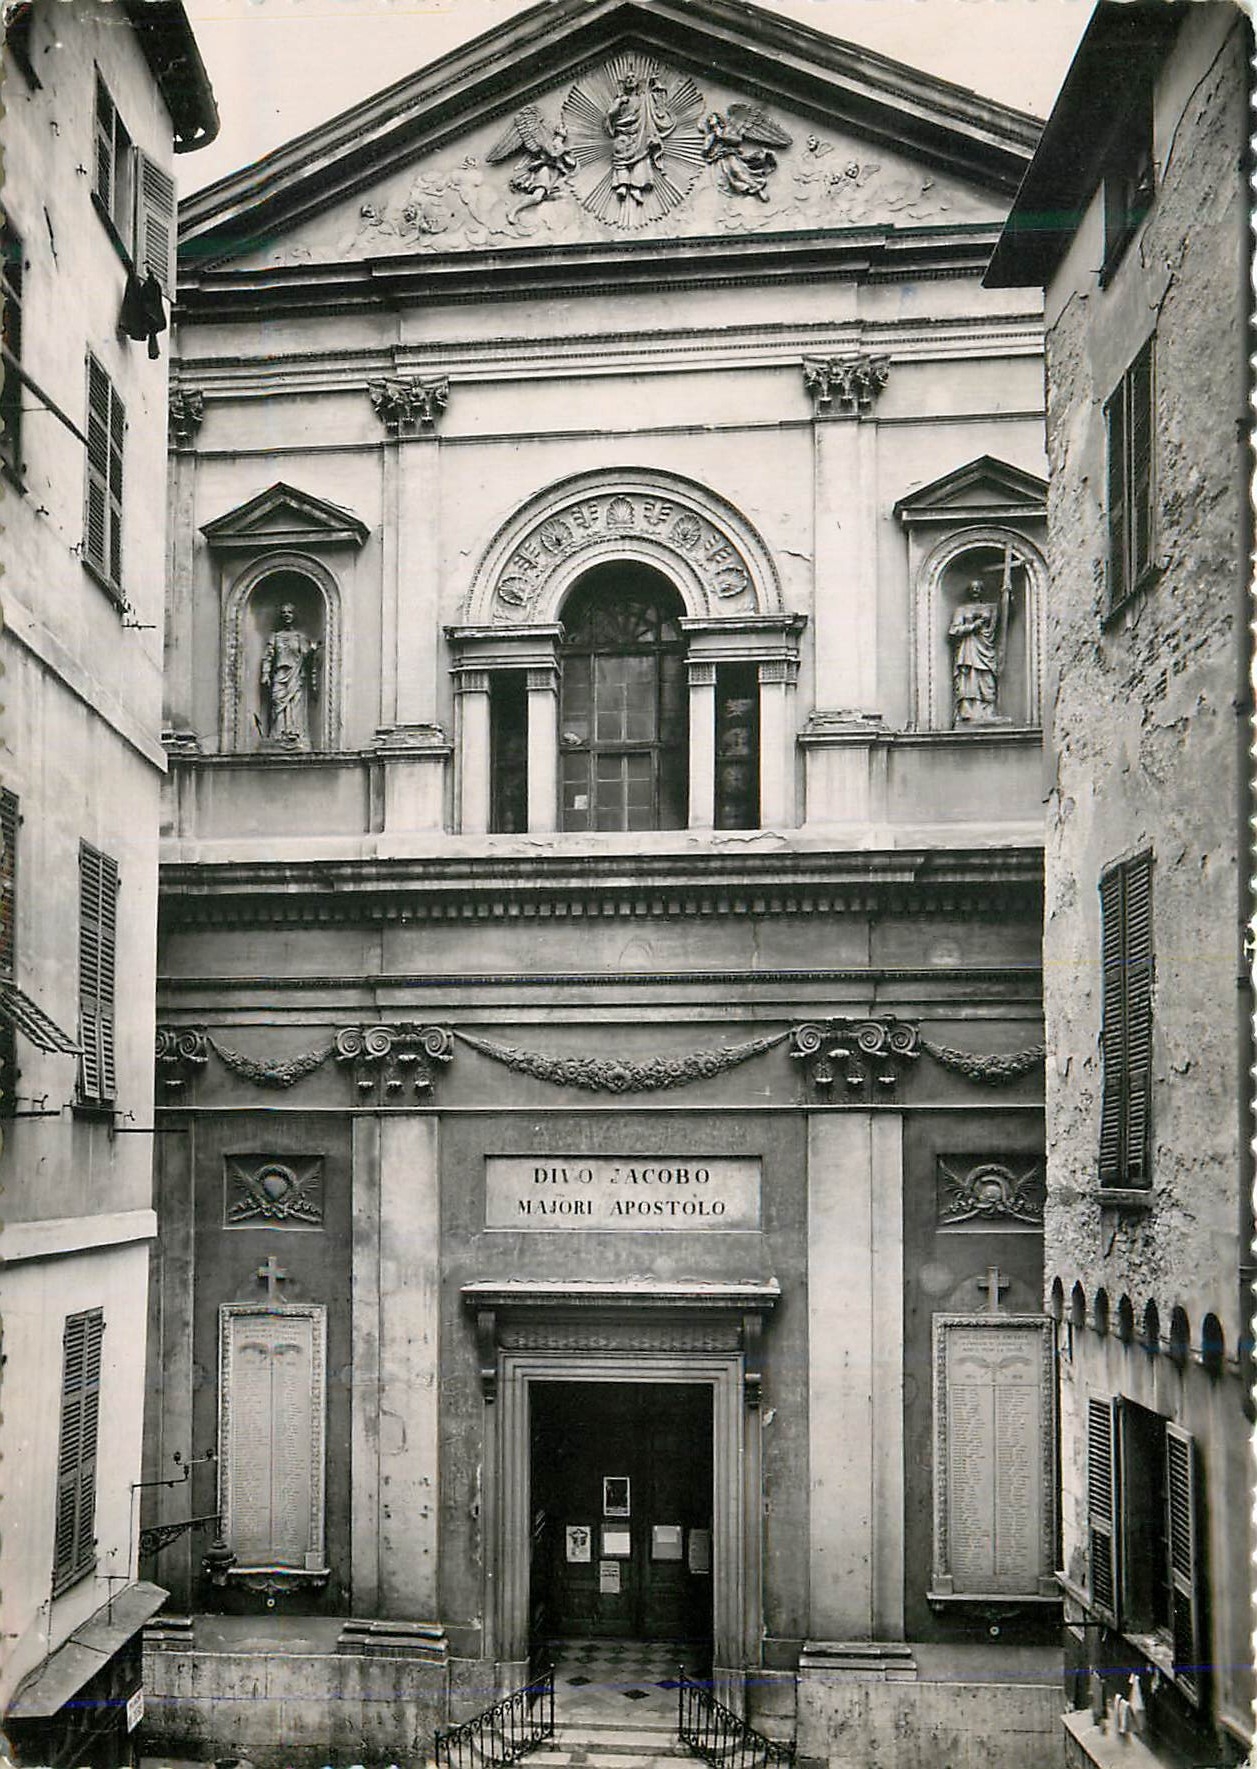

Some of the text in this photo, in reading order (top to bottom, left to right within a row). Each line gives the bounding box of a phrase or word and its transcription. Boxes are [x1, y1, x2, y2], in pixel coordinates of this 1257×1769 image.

[533, 1168, 593, 1185] DIVO
[517, 1199, 726, 1216] MAJORI APOSTOLO
